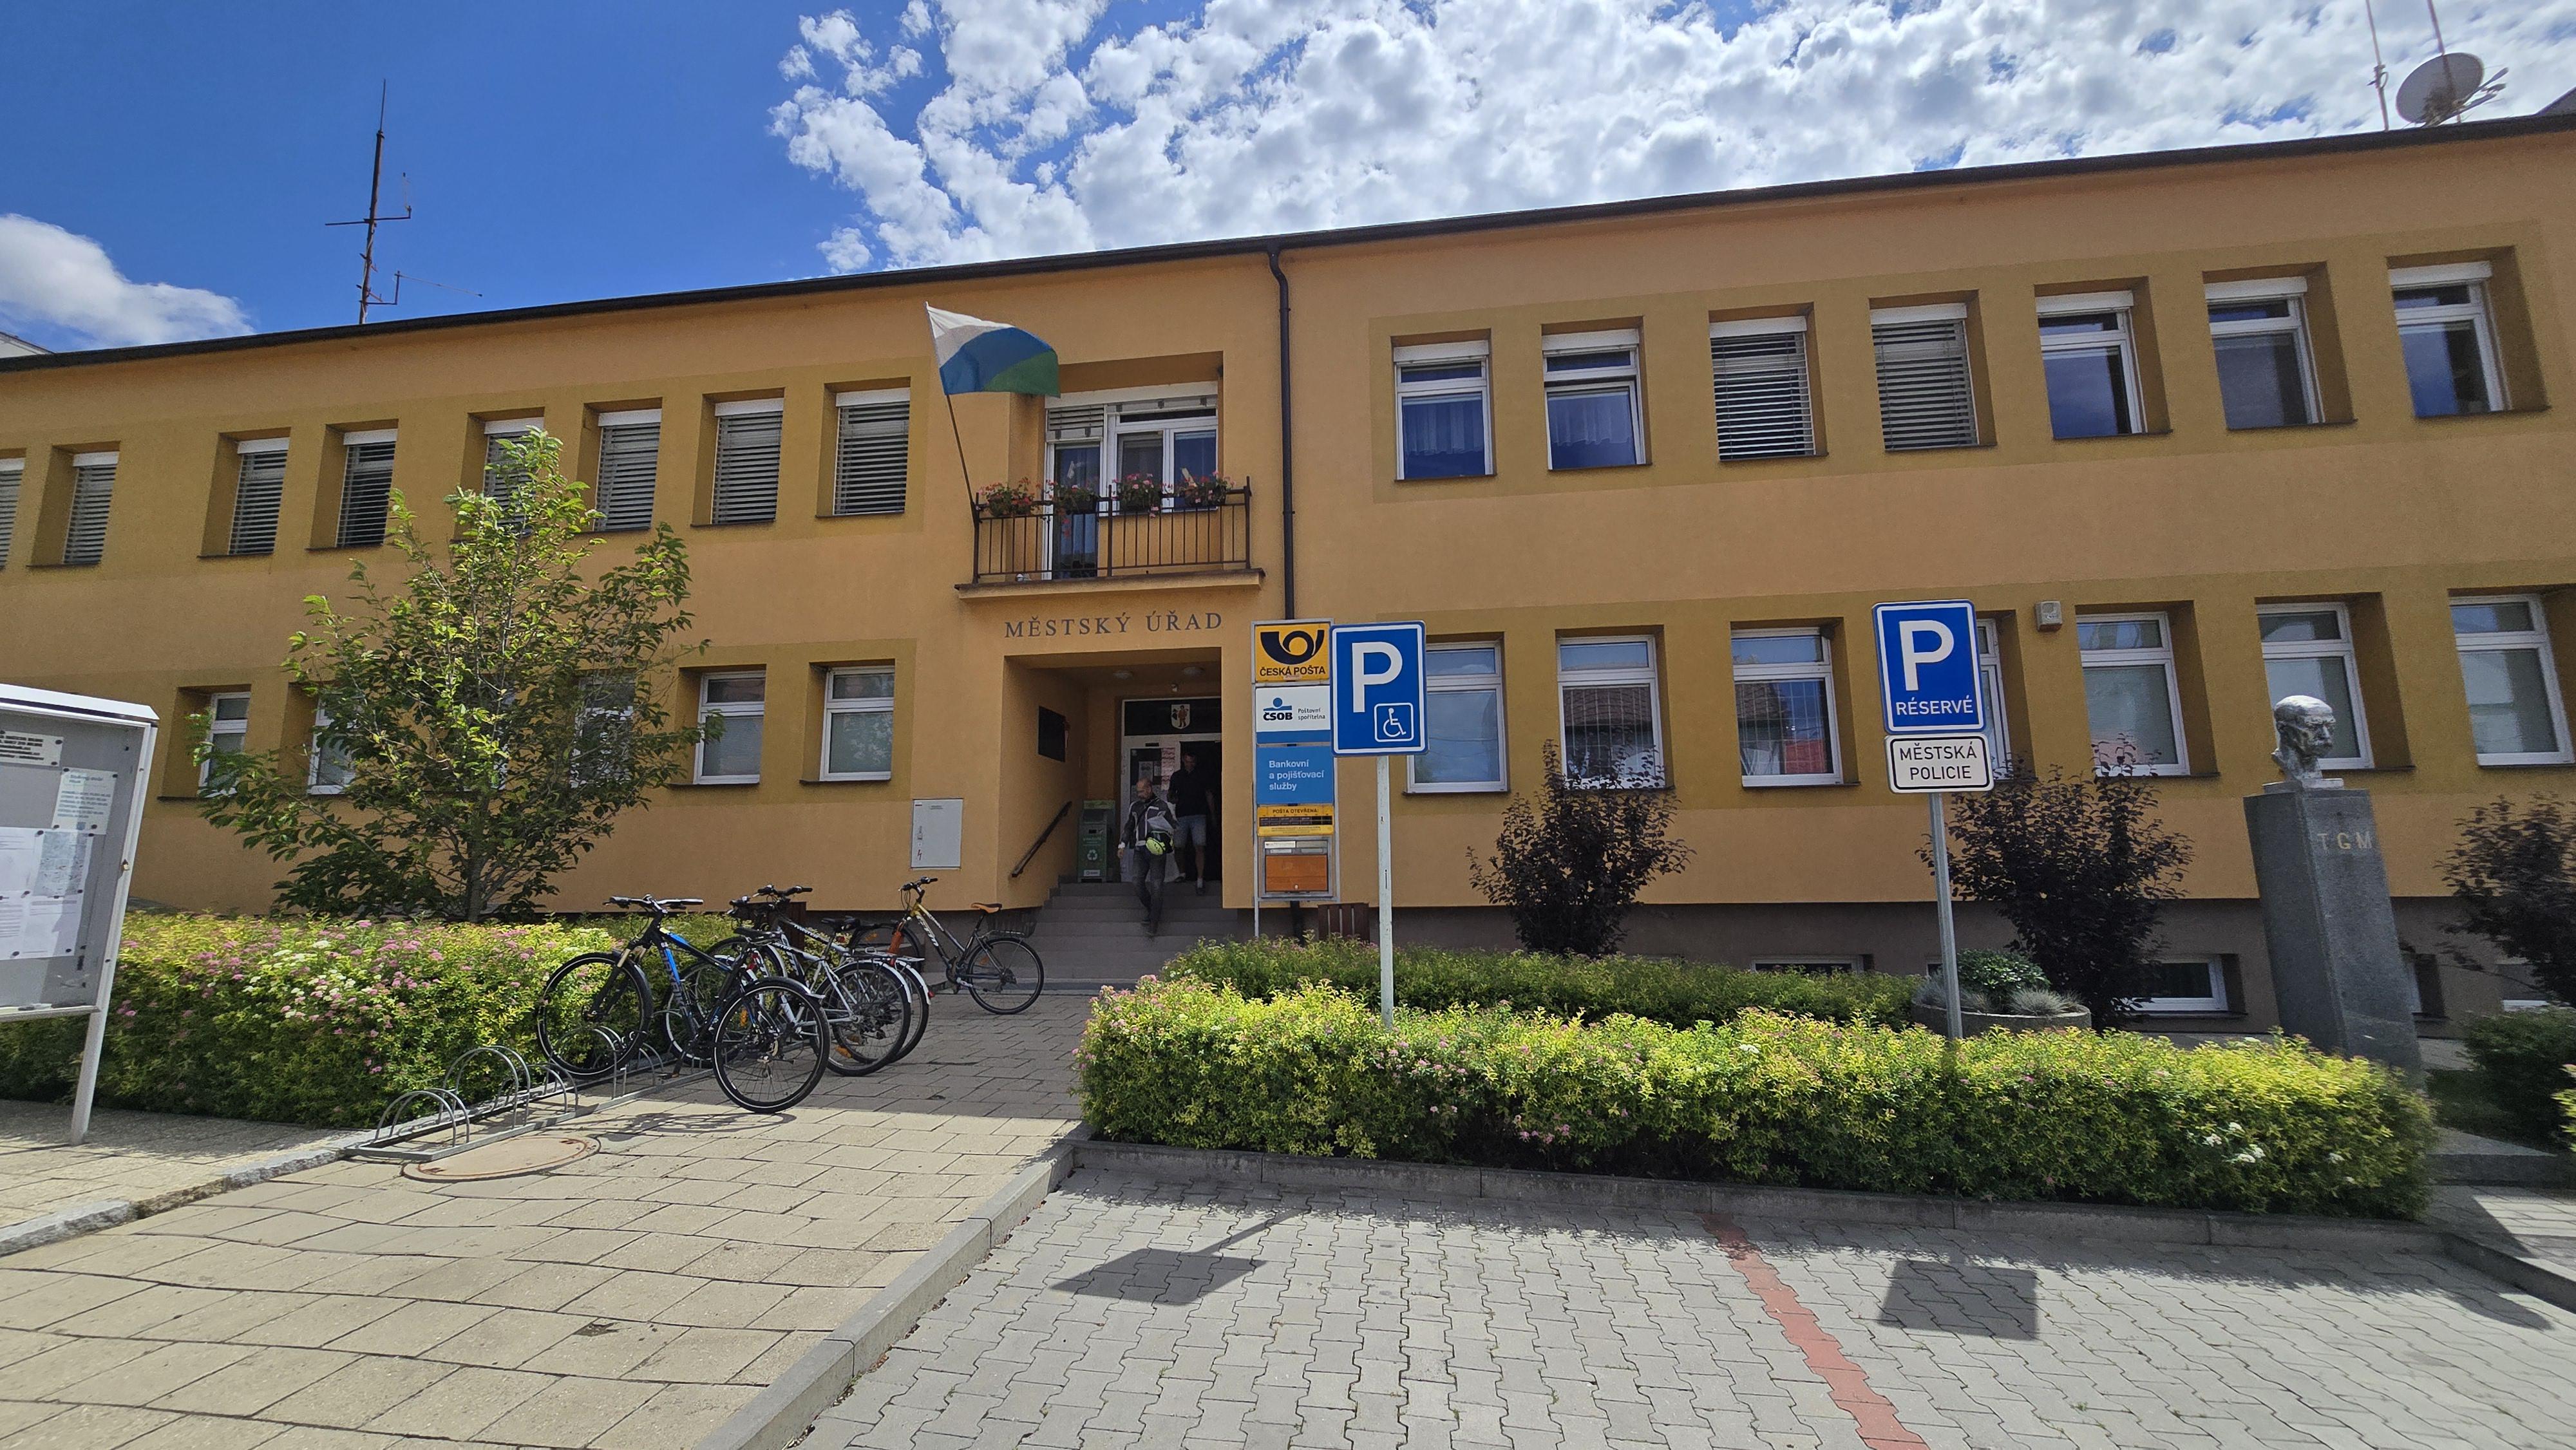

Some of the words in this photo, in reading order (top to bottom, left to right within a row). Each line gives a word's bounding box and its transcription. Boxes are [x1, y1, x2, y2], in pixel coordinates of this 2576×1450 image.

[1004, 612, 1130, 638] MĚSTSKÝ
[1145, 610, 1222, 632] ÚŘAD
[1899, 620, 1955, 691] P
[1260, 666, 1292, 676] ČESKÁ
[1293, 665, 1326, 675] POŠTA
[1352, 641, 1403, 713] P
[1896, 695, 1973, 715] RÉSERVÉ
[1263, 711, 1293, 721] ČSOB
[1900, 741, 1977, 760] MĚSTSKÁ
[1269, 759, 1309, 768] Bankovní
[1277, 770, 1325, 780] pojišťovací
[1910, 766, 1972, 780] POLICIE
[1269, 782, 1297, 791] služby
